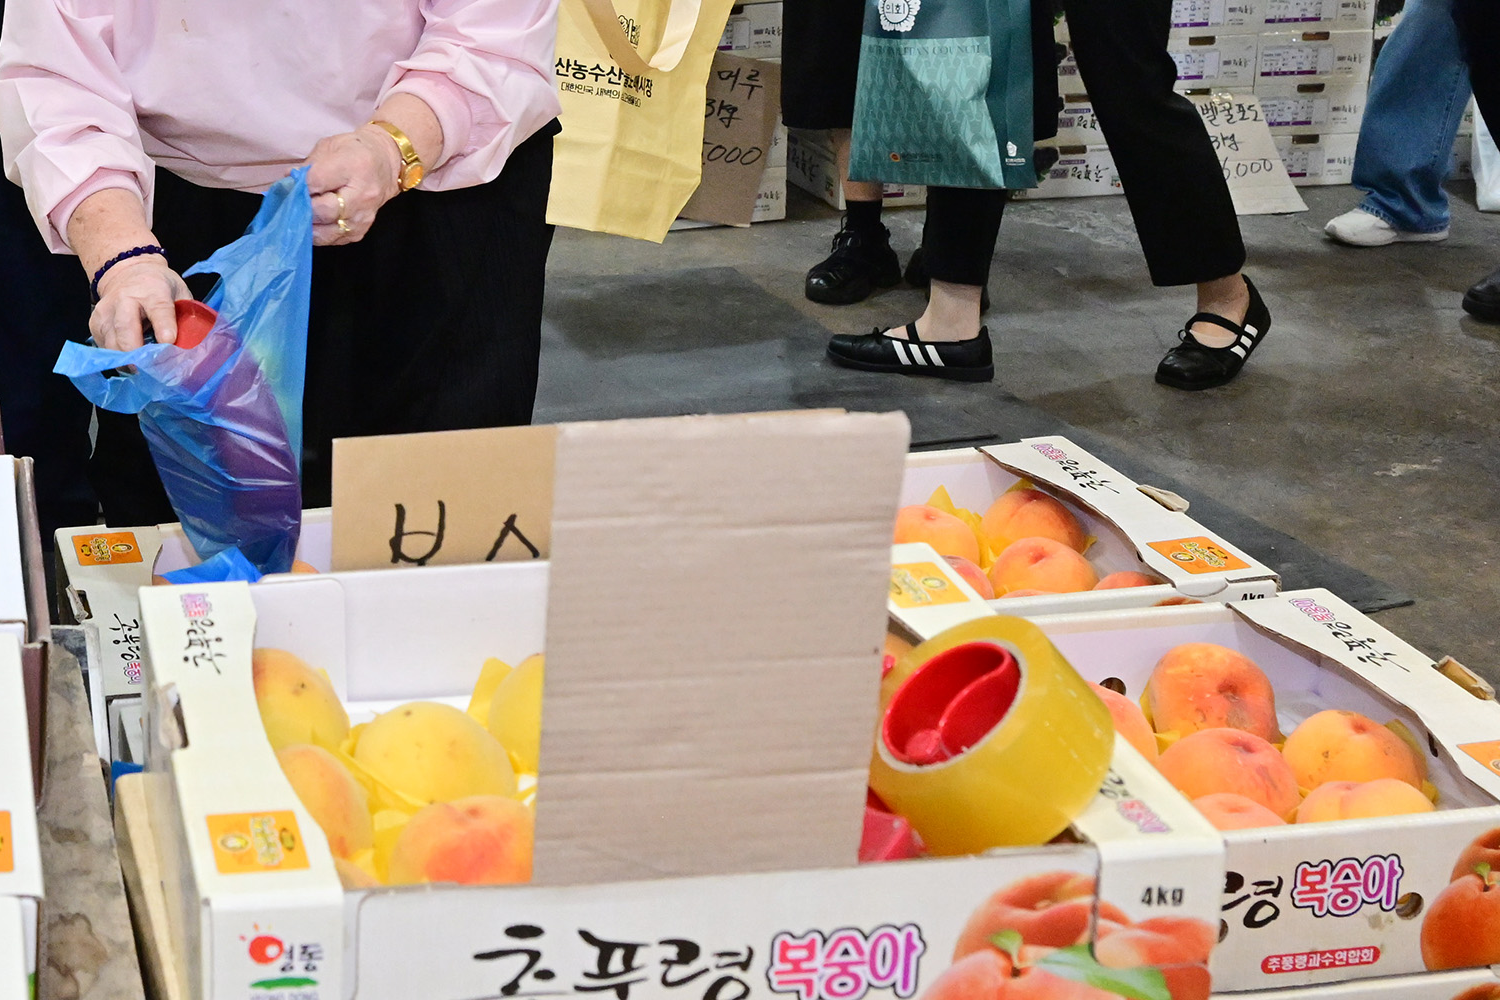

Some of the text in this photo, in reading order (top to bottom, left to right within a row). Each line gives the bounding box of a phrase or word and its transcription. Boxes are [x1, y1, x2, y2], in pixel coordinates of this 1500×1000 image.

[885, 3, 906, 15] 의회
[1140, 886, 1185, 907] 4kg
[1291, 853, 1404, 917] 복숭아
[769, 922, 926, 1000] 복숭아
[1266, 947, 1375, 972] 추풍령과수연합회
